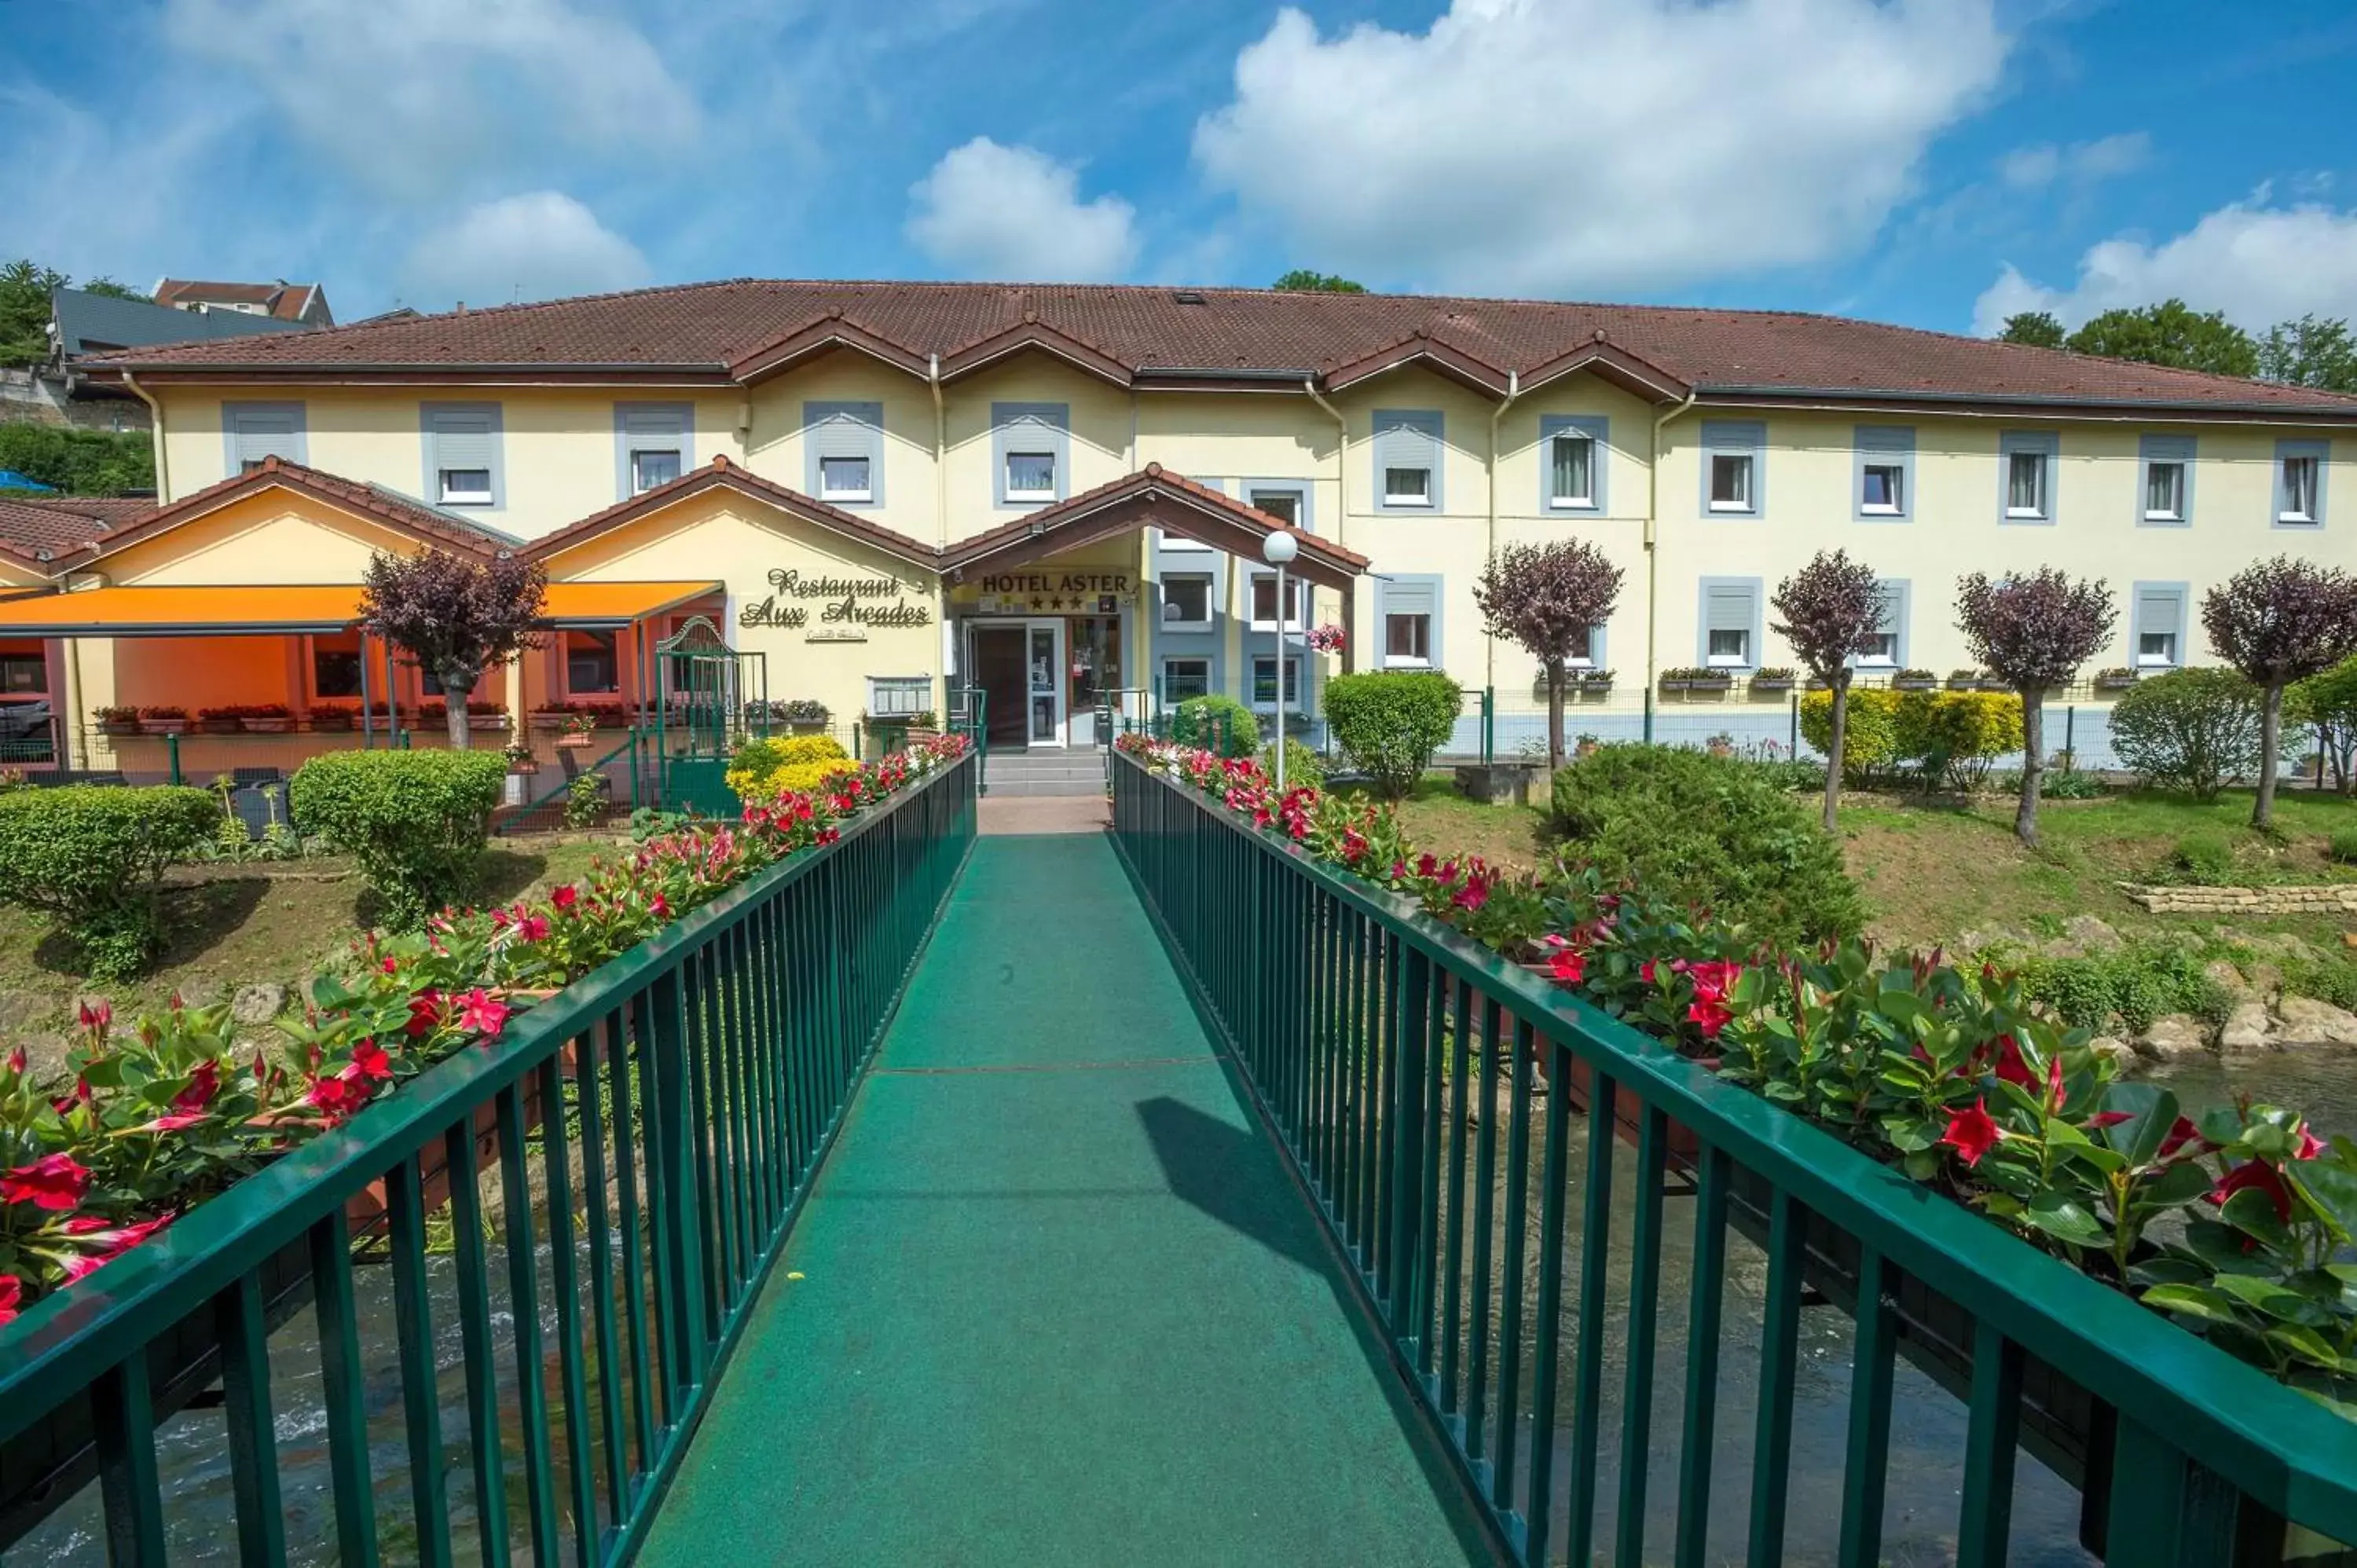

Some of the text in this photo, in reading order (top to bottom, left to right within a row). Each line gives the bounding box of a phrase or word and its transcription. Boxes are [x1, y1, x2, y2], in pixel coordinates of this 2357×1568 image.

[768, 568, 901, 598] Restaurant
[983, 574, 1127, 592] HOTEL ASTER
[740, 595, 931, 628] Aux Arcades
